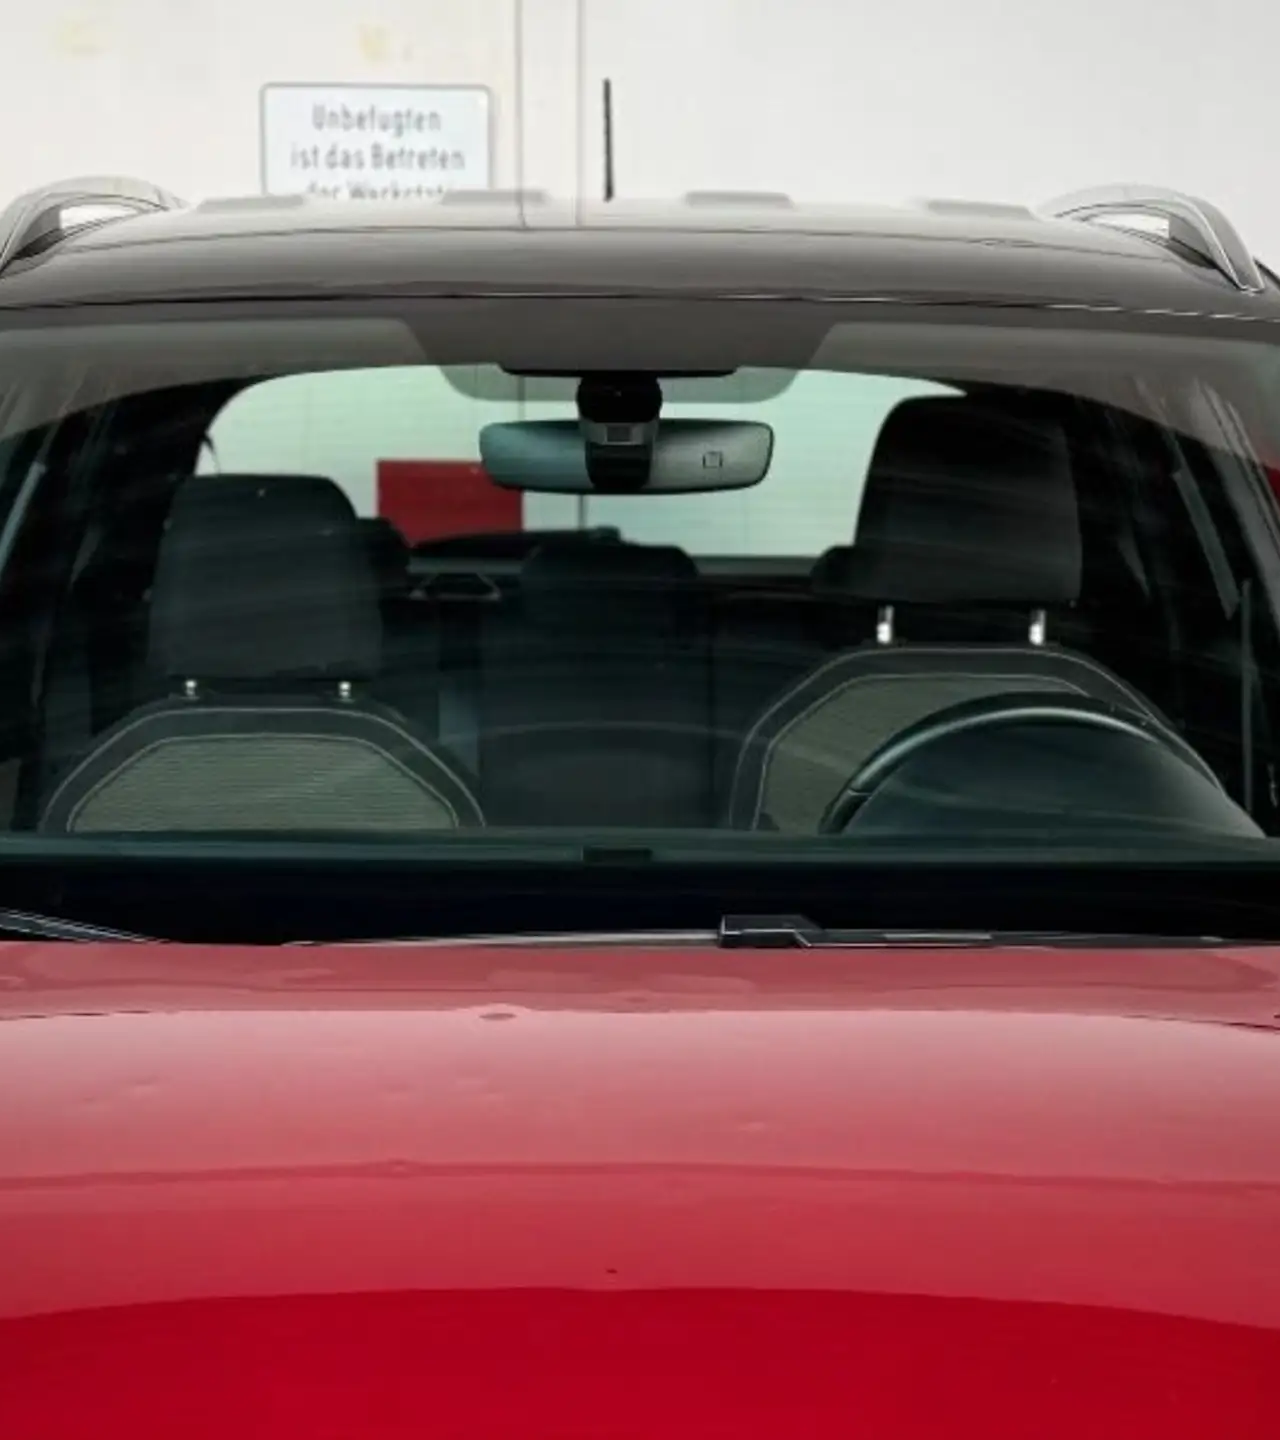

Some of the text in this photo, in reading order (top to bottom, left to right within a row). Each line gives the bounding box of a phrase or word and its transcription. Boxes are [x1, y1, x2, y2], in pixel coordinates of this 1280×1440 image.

[311, 104, 442, 137] Unbefugten
[290, 141, 466, 171] ist das Betreten
